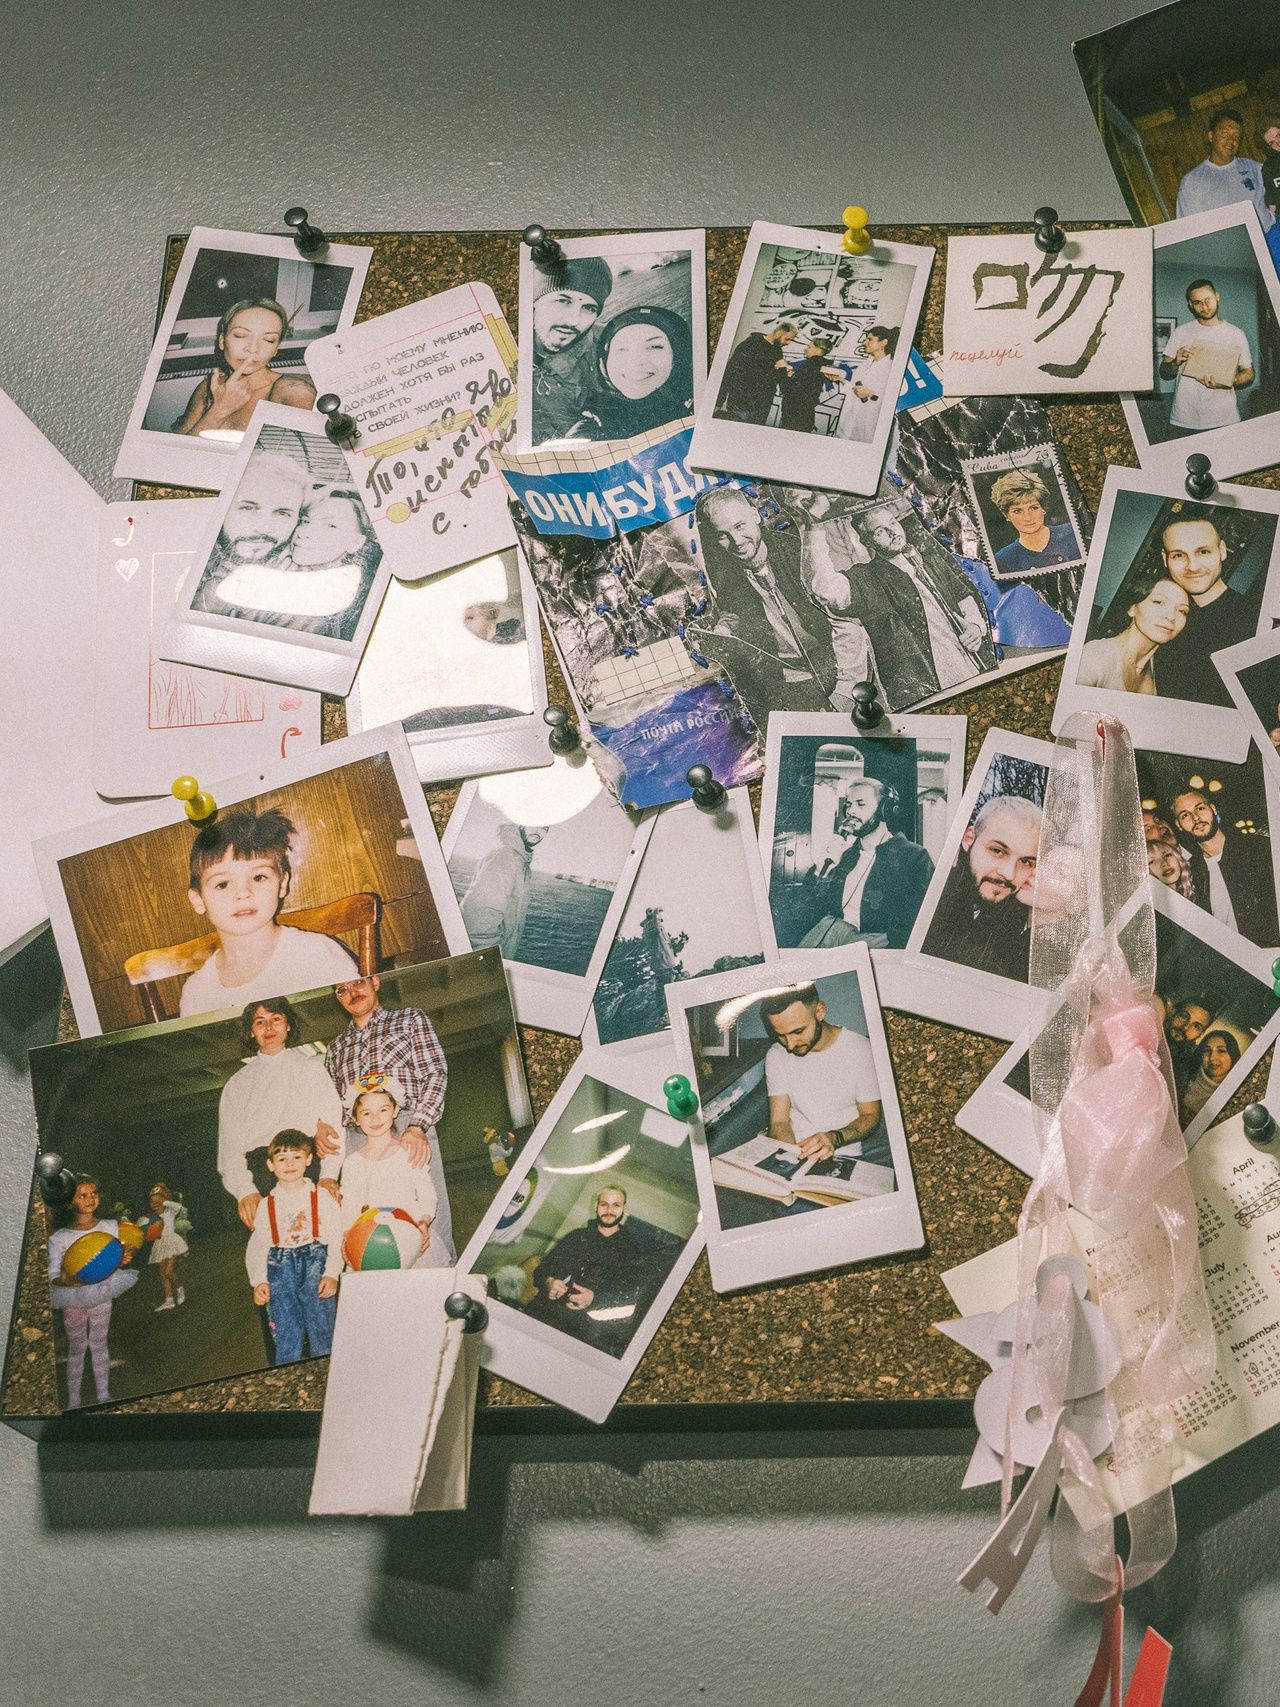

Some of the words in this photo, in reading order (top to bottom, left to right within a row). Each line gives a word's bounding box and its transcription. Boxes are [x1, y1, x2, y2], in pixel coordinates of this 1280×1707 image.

[363, 361, 381, 374] ПО
[385, 342, 427, 366] МОЕМУ
[391, 350, 450, 377] ЧЕЛОВЕК
[949, 343, 1024, 367] поцелуй
[343, 386, 396, 413] ДОЛЖЕН
[399, 371, 433, 390] ХОТЯ
[437, 362, 457, 376] БЫ
[461, 352, 485, 367] РАЗ
[352, 396, 412, 423] СПЫТАТЬ
[368, 409, 410, 433] СВОЕЙ
[413, 391, 462, 415] ЖИЗНИ?
[967, 461, 999, 473] Cuba
[640, 720, 684, 741] ПОЧТА
[1232, 1157, 1255, 1175] April
[1204, 1262, 1225, 1278] July
[1230, 1321, 1280, 1353] November
